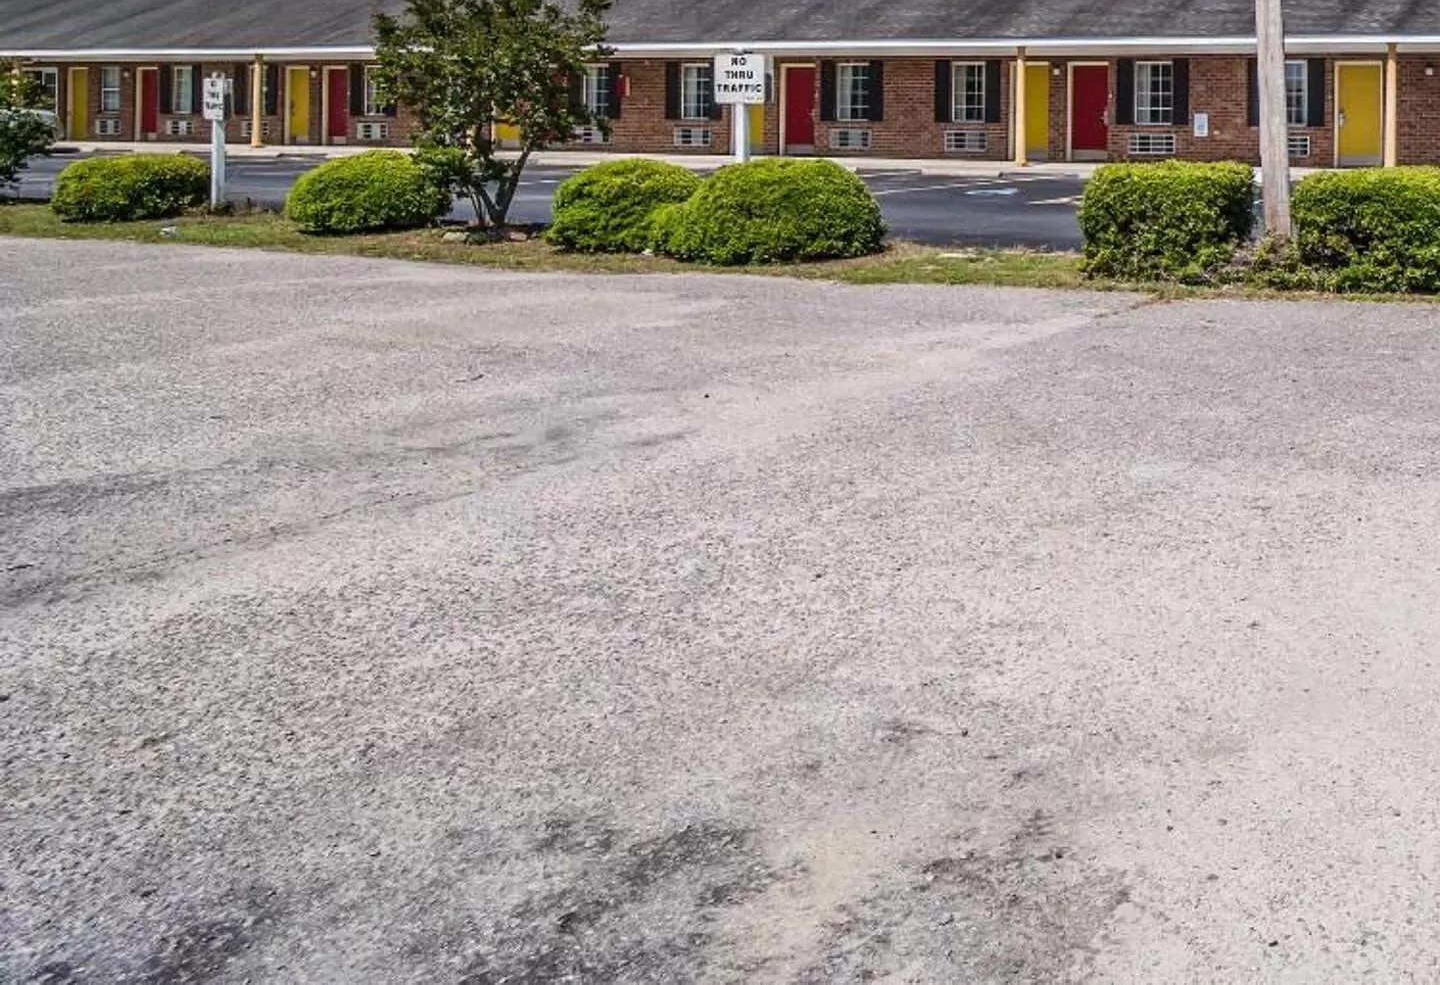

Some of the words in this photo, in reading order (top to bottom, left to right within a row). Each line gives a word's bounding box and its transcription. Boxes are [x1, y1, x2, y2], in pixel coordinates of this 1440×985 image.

[730, 56, 748, 67] NO
[723, 70, 754, 80] THRU
[717, 83, 762, 93] TRAFFIC
